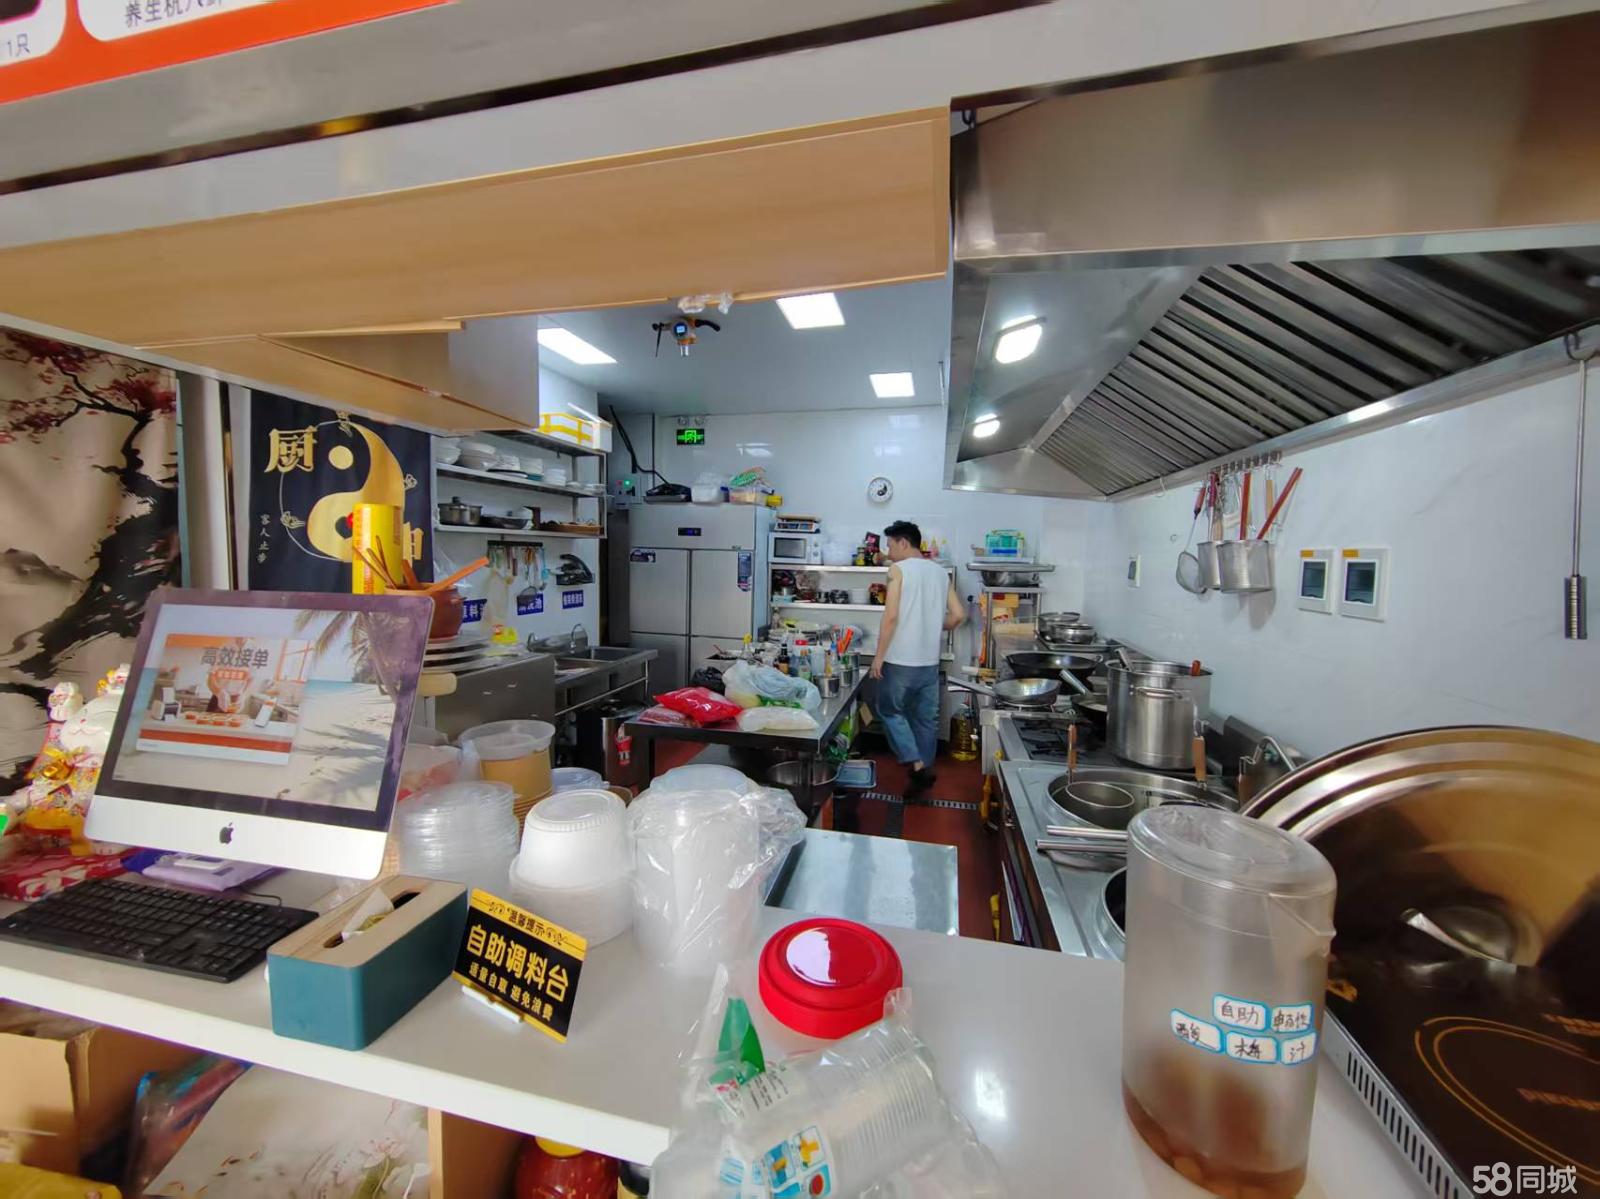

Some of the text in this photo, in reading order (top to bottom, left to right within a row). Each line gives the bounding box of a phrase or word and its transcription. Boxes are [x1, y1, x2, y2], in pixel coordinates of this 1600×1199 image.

[264, 425, 319, 473] 厨
[200, 646, 269, 669] 高效接单
[508, 906, 545, 936] 温馨提示
[467, 924, 569, 1002] 自助调料台
[469, 962, 554, 1021] 适量自取 避免浪费
[1221, 1001, 1260, 1026] 自助
[1289, 1041, 1306, 1061] 汁
